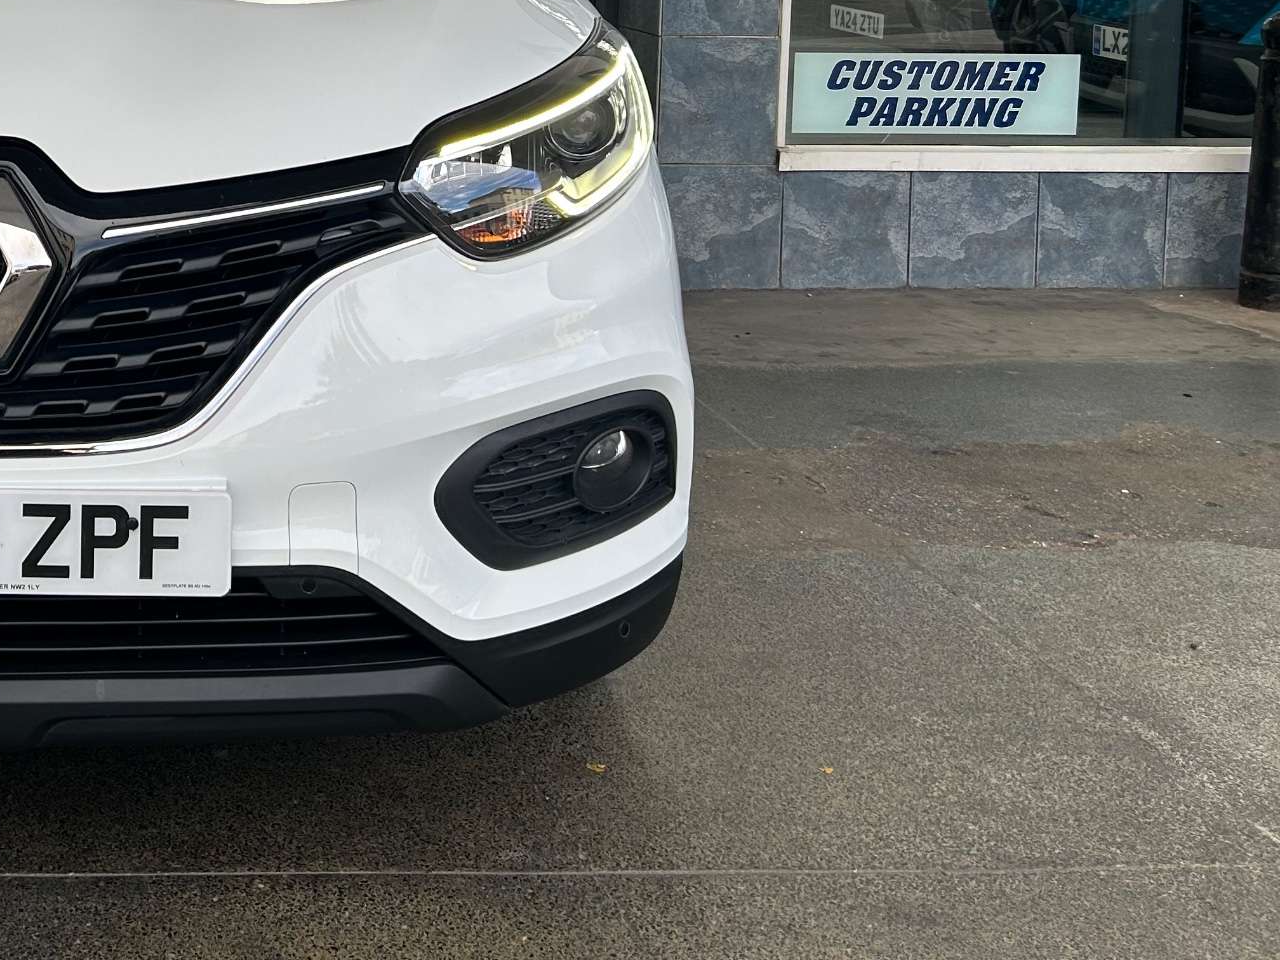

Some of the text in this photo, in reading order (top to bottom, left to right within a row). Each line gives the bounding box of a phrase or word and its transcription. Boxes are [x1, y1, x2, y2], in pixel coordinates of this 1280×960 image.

[827, 59, 1046, 91] CUSTOMER
[846, 96, 1023, 128] PARKING
[21, 503, 189, 580] ZPF
